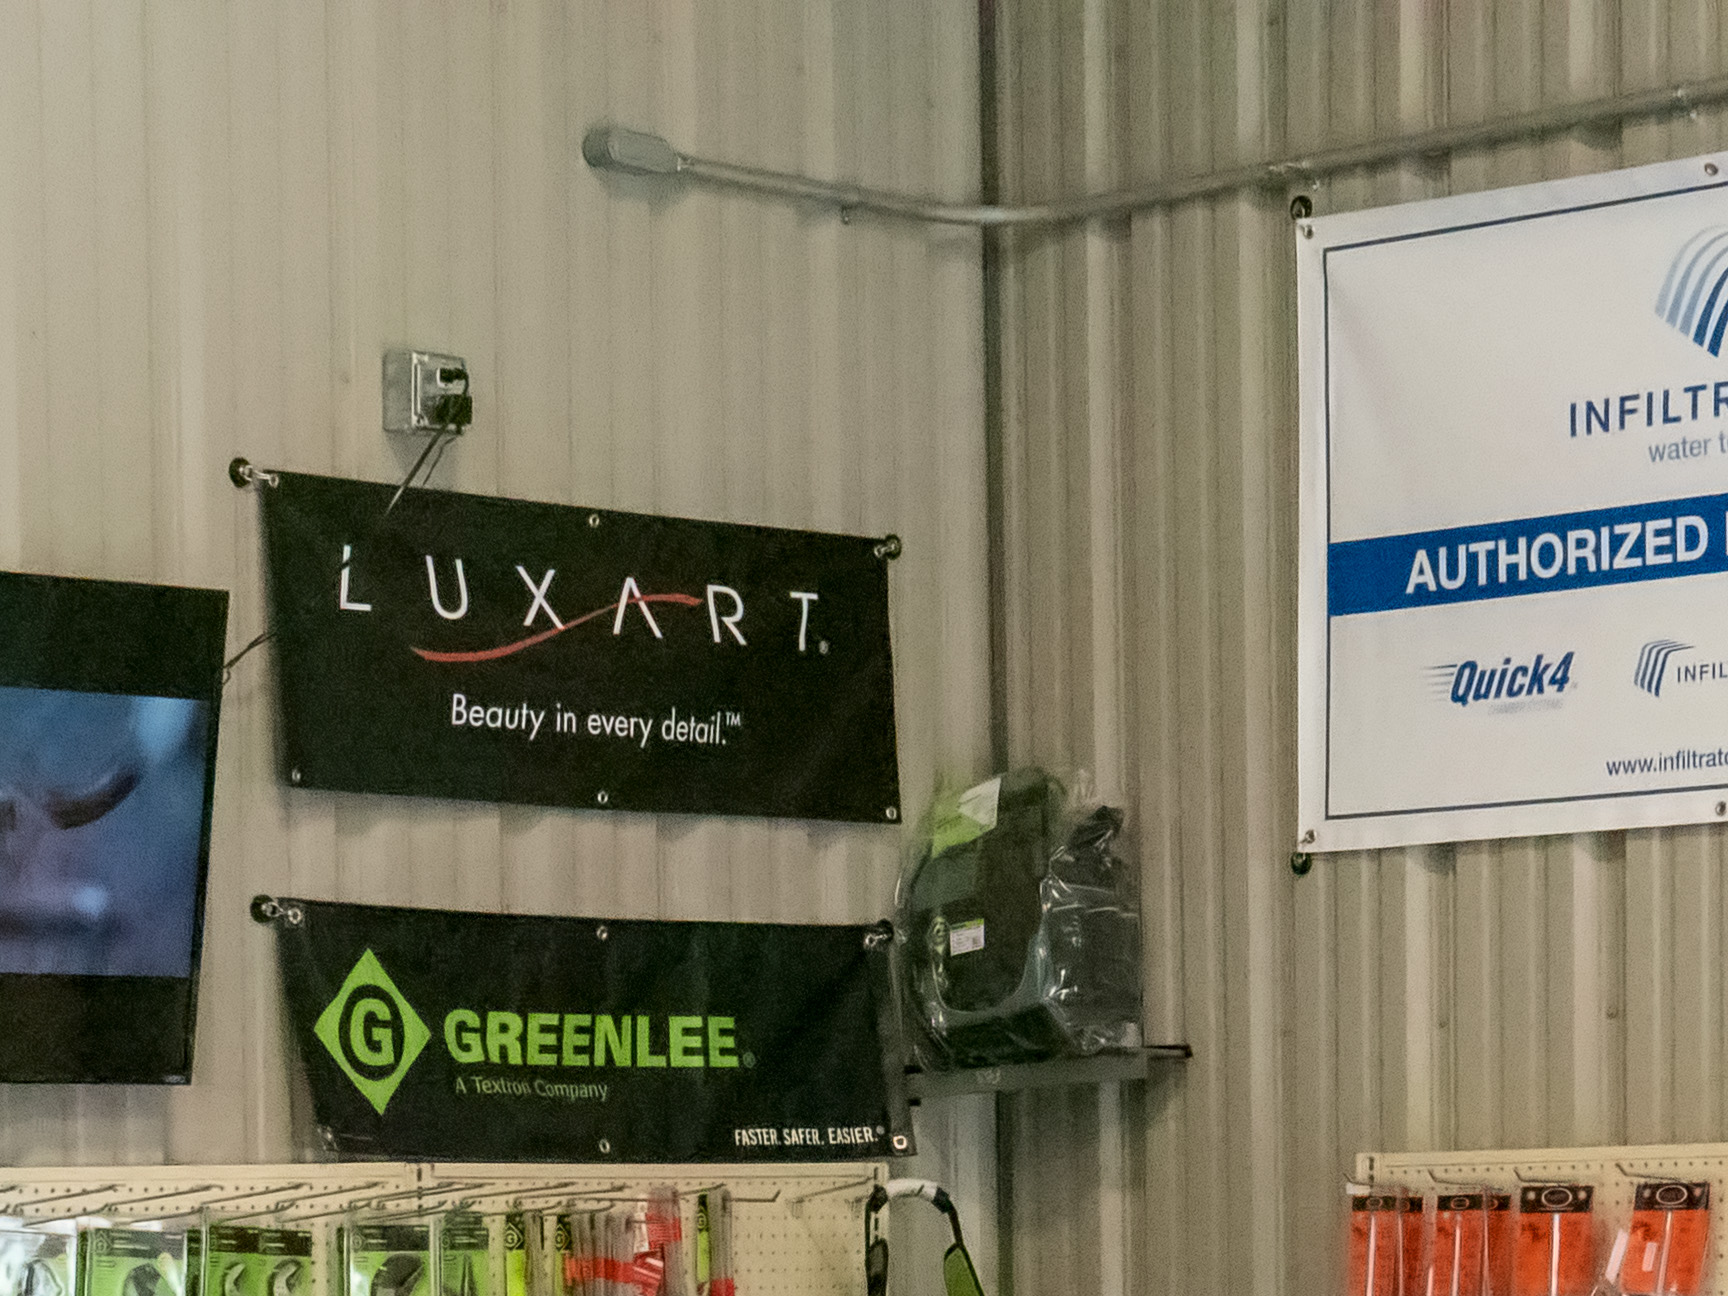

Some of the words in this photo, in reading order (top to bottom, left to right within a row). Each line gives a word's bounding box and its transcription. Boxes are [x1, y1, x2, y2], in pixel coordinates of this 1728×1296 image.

[1648, 432, 1712, 465] water
[1405, 512, 1710, 597] AUTHORIZED
[338, 542, 820, 654] LUXART
[1450, 651, 1576, 708] Quick4
[450, 692, 545, 741] Beauty
[556, 702, 578, 735] in
[587, 708, 654, 748] every
[444, 1009, 741, 1070] GREENLEE
[454, 1076, 467, 1095] A
[471, 1075, 532, 1097] Textron
[534, 1078, 609, 1101] Company
[734, 1127, 782, 1147] FASTER.
[783, 1127, 825, 1147] SAFER.
